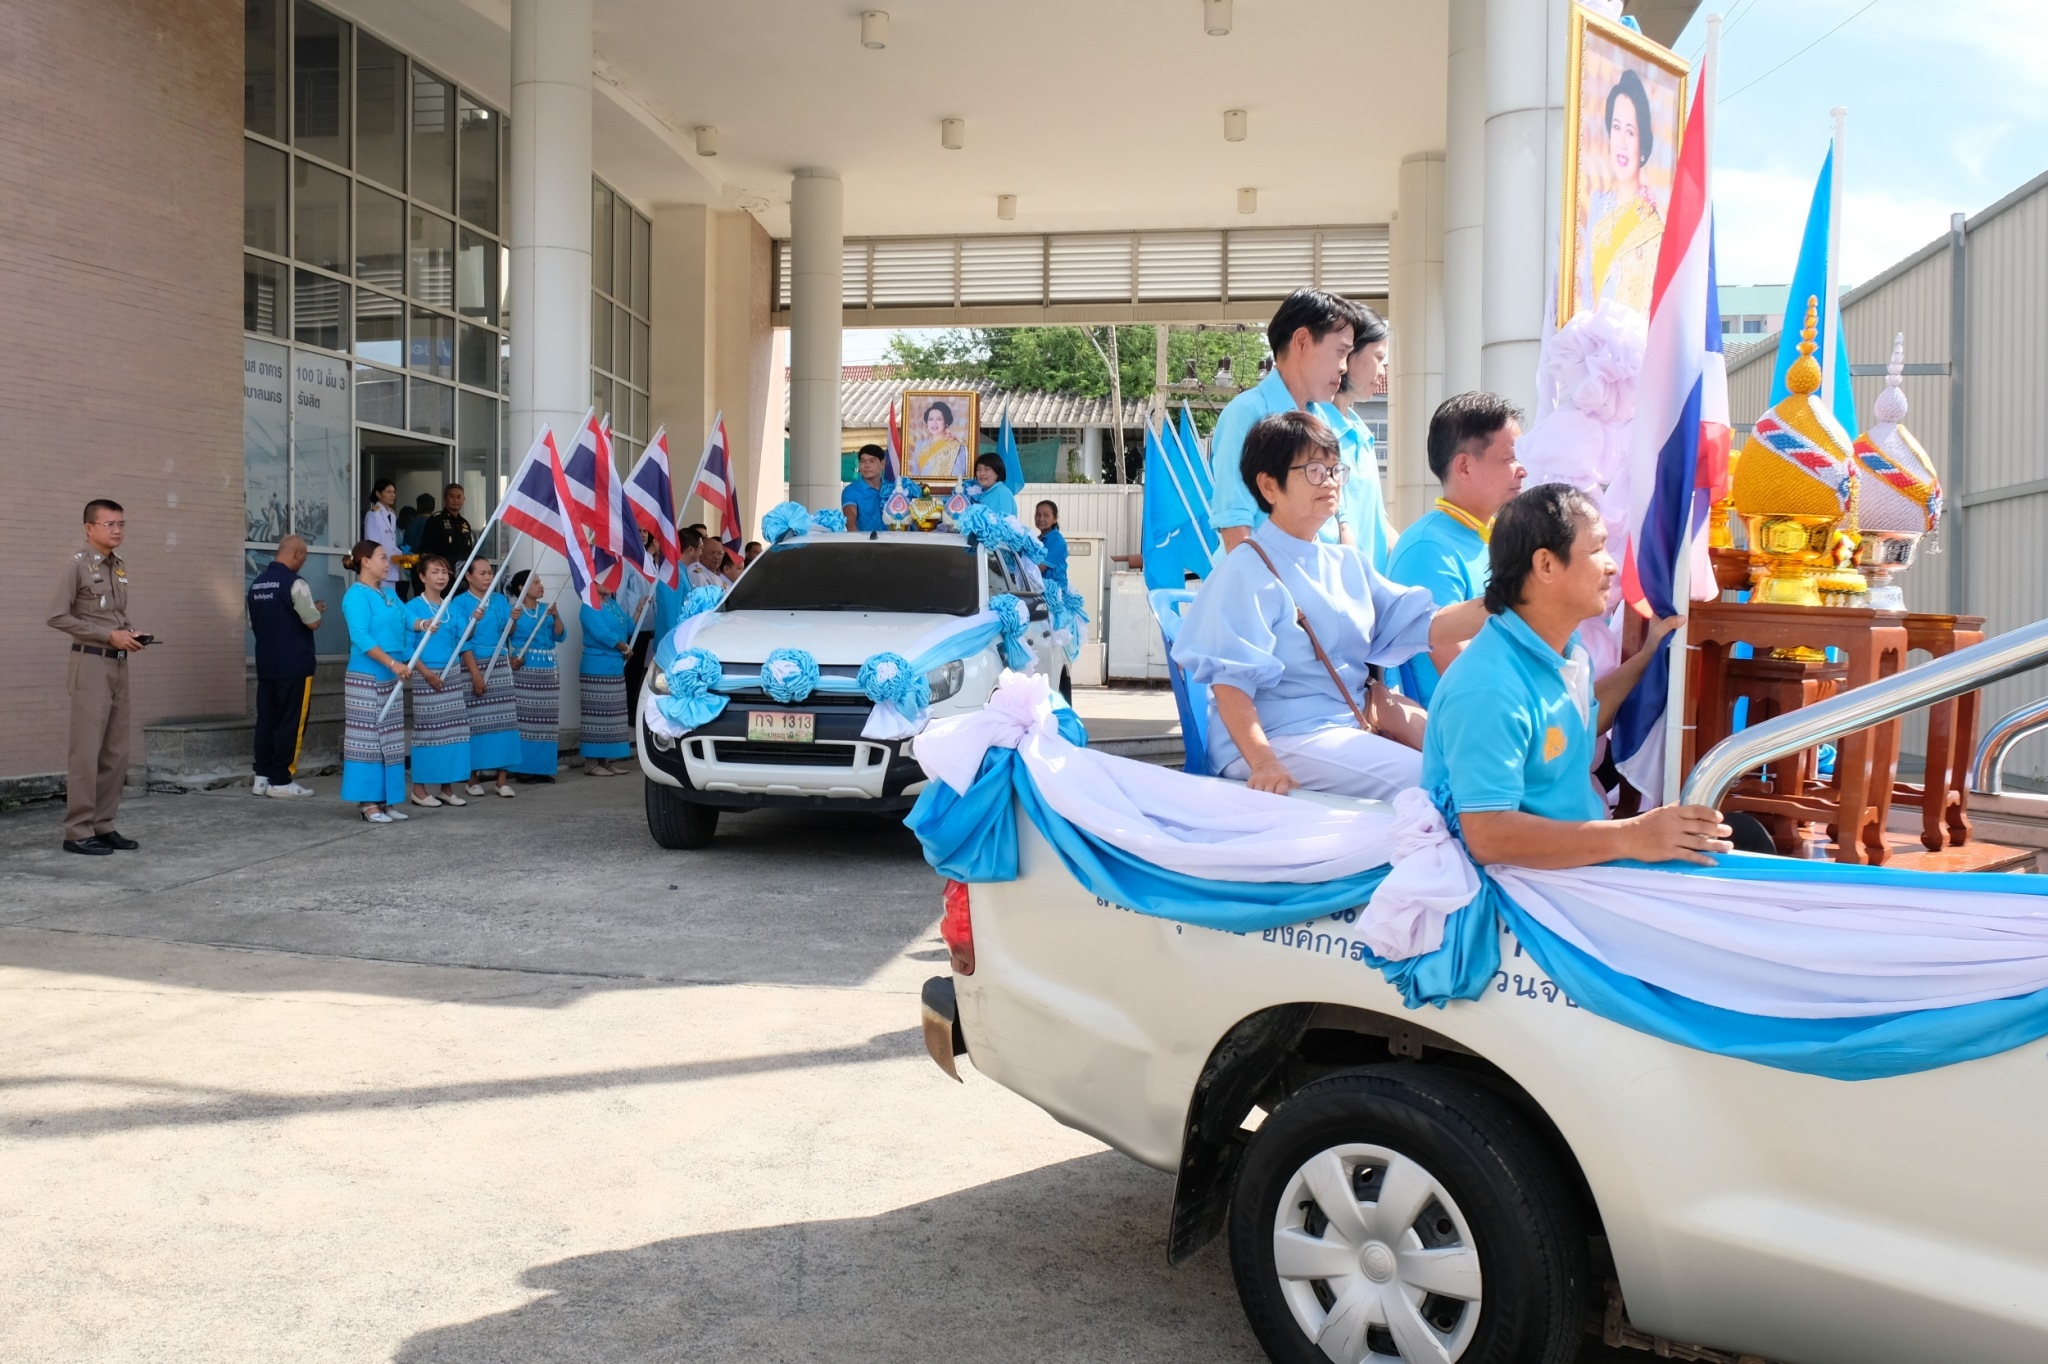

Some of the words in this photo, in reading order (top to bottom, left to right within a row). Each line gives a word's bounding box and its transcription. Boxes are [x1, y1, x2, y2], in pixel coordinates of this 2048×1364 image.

[244, 360, 256, 374] นส
[259, 362, 283, 378] อาคาร
[296, 366, 314, 382] 100
[316, 369, 323, 385] ปี
[326, 367, 337, 388] ชั้น
[339, 378, 346, 391] 3
[297, 391, 321, 408] รังสิต
[755, 714, 774, 727] กจ
[782, 715, 812, 729] 1313
[1262, 920, 1366, 962] องค์การ
[1491, 969, 1580, 1009] วนจ
